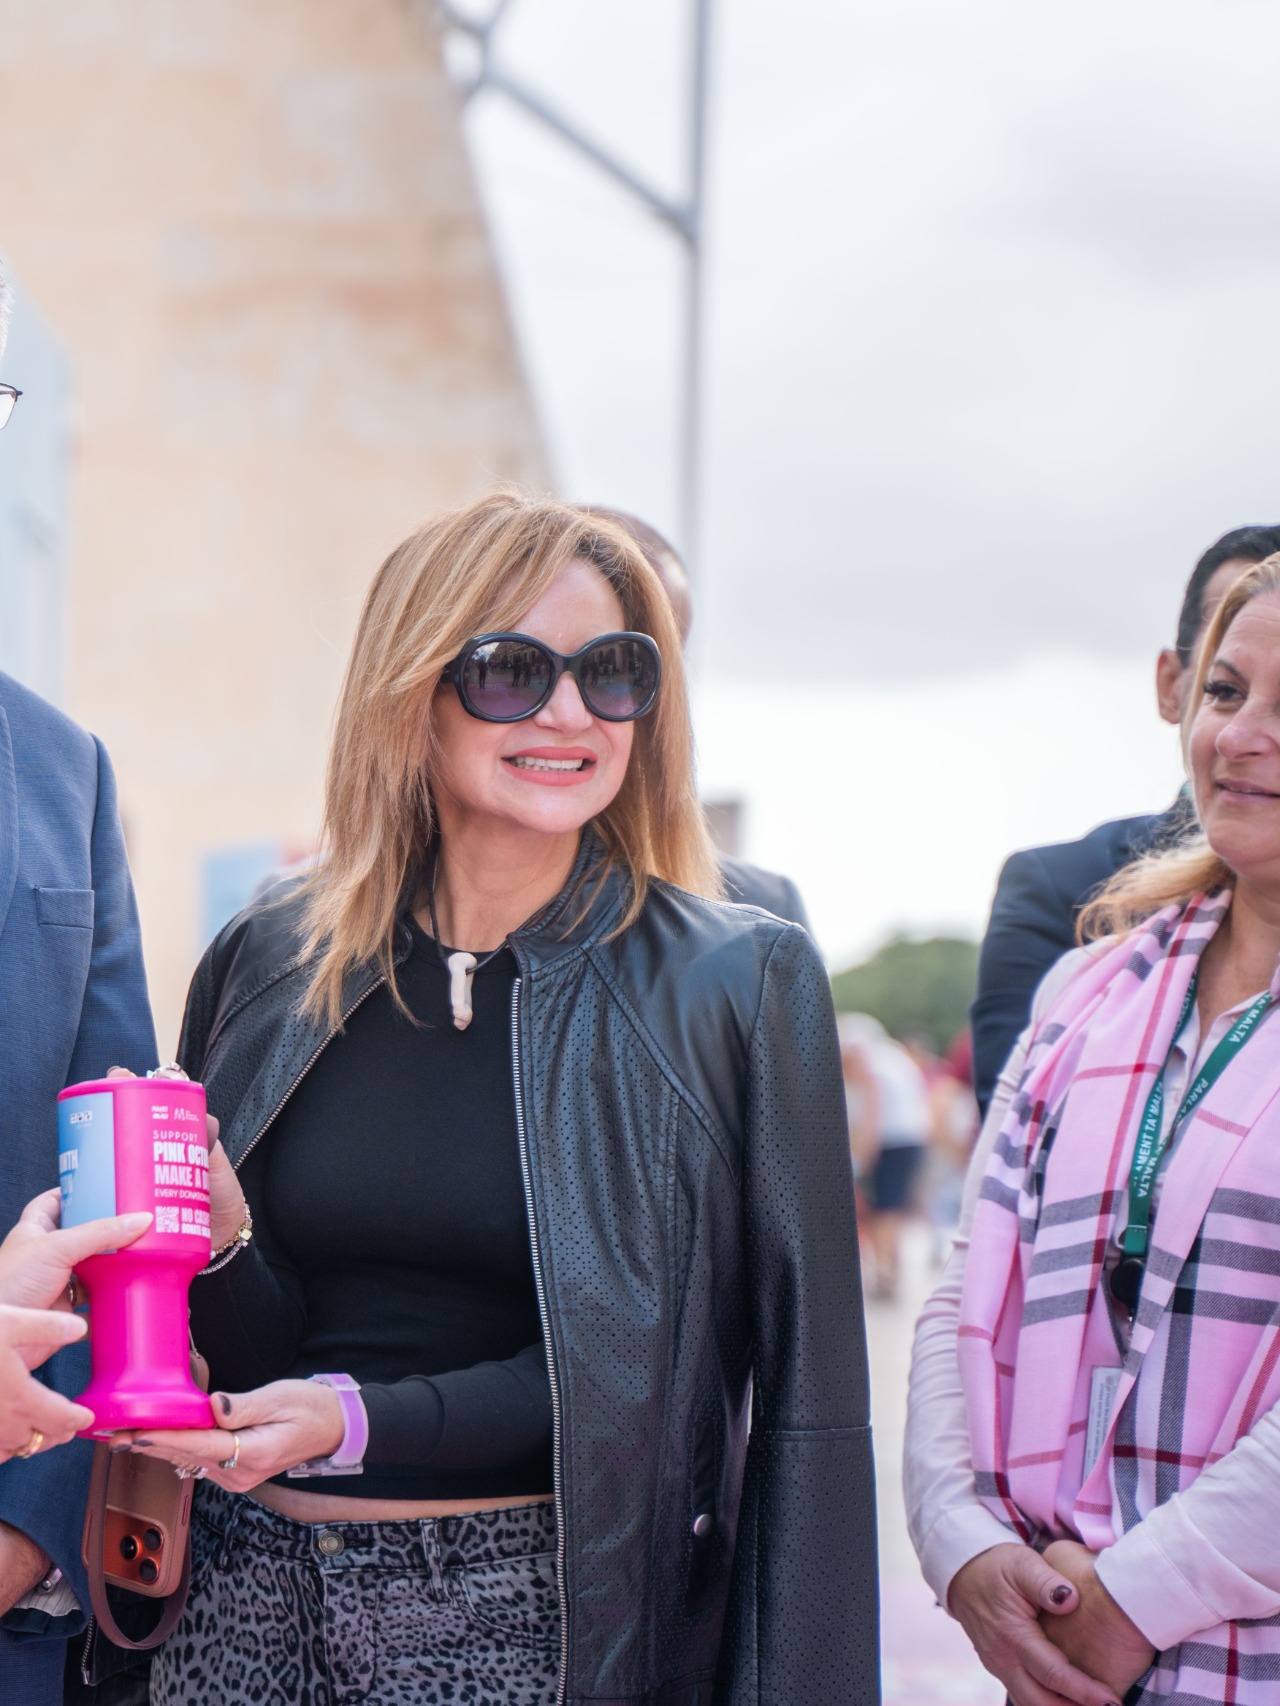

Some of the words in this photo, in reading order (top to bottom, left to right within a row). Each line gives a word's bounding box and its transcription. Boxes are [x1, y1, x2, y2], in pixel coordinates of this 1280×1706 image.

[1228, 1008, 1260, 1043] MALTA
[152, 1130, 198, 1143] SUPPORT
[153, 1141, 186, 1163] PINK
[154, 1164, 193, 1187] MAKE
[194, 1167, 202, 1189] A
[1137, 1156, 1158, 1198] MALTA
[154, 1188, 178, 1198] EVERY
[181, 1207, 194, 1223] NO
